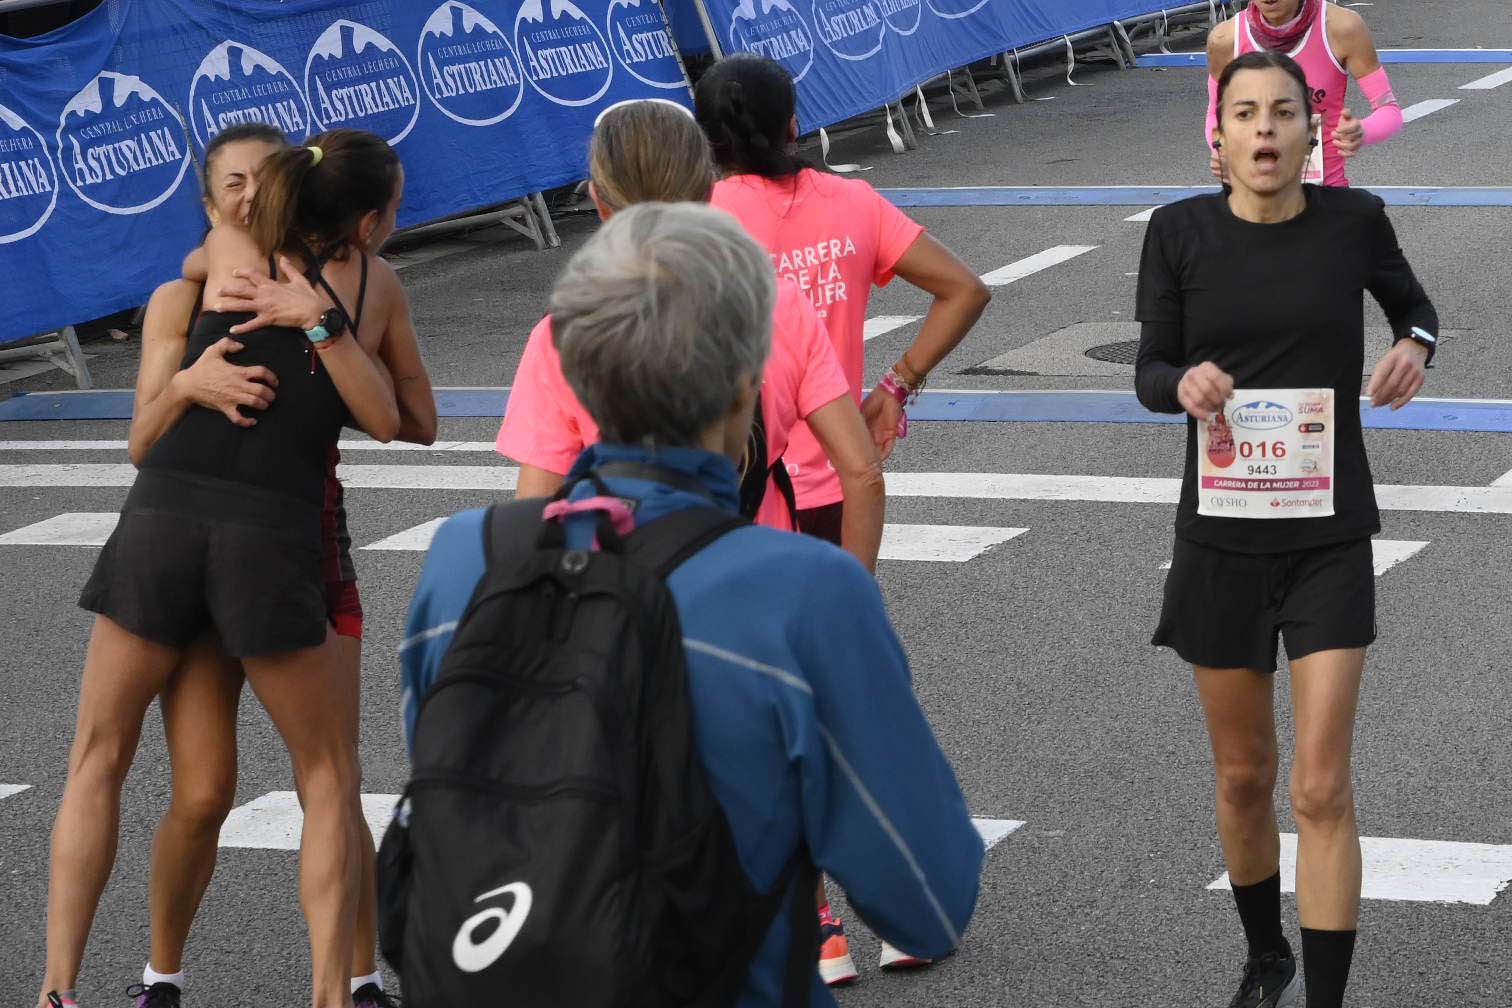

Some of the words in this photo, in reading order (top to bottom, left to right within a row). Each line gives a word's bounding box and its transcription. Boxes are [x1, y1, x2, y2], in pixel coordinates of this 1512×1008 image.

[531, 28, 561, 43] CENTRAL
[562, 24, 592, 38] LECHERA
[438, 44, 471, 59] CENTRAL
[523, 36, 609, 81] ASTURIANA
[325, 65, 366, 83] CENTRAL
[367, 58, 400, 76] LECHERA
[428, 51, 520, 99] ASTURIANA
[315, 74, 416, 125] ASTURIANA
[817, 261, 842, 285] LA
[810, 281, 848, 307] JER
[1235, 412, 1289, 424] ASTURIANA
[1239, 440, 1287, 459] 016
[1247, 464, 1277, 476] 9443
[1213, 479, 1246, 489] CARRERA
[1247, 480, 1258, 489] DE
[1260, 480, 1271, 489] LA
[1272, 479, 1300, 489] MUJER
[1210, 495, 1247, 508] OYSHO
[1281, 498, 1323, 508] Santander
